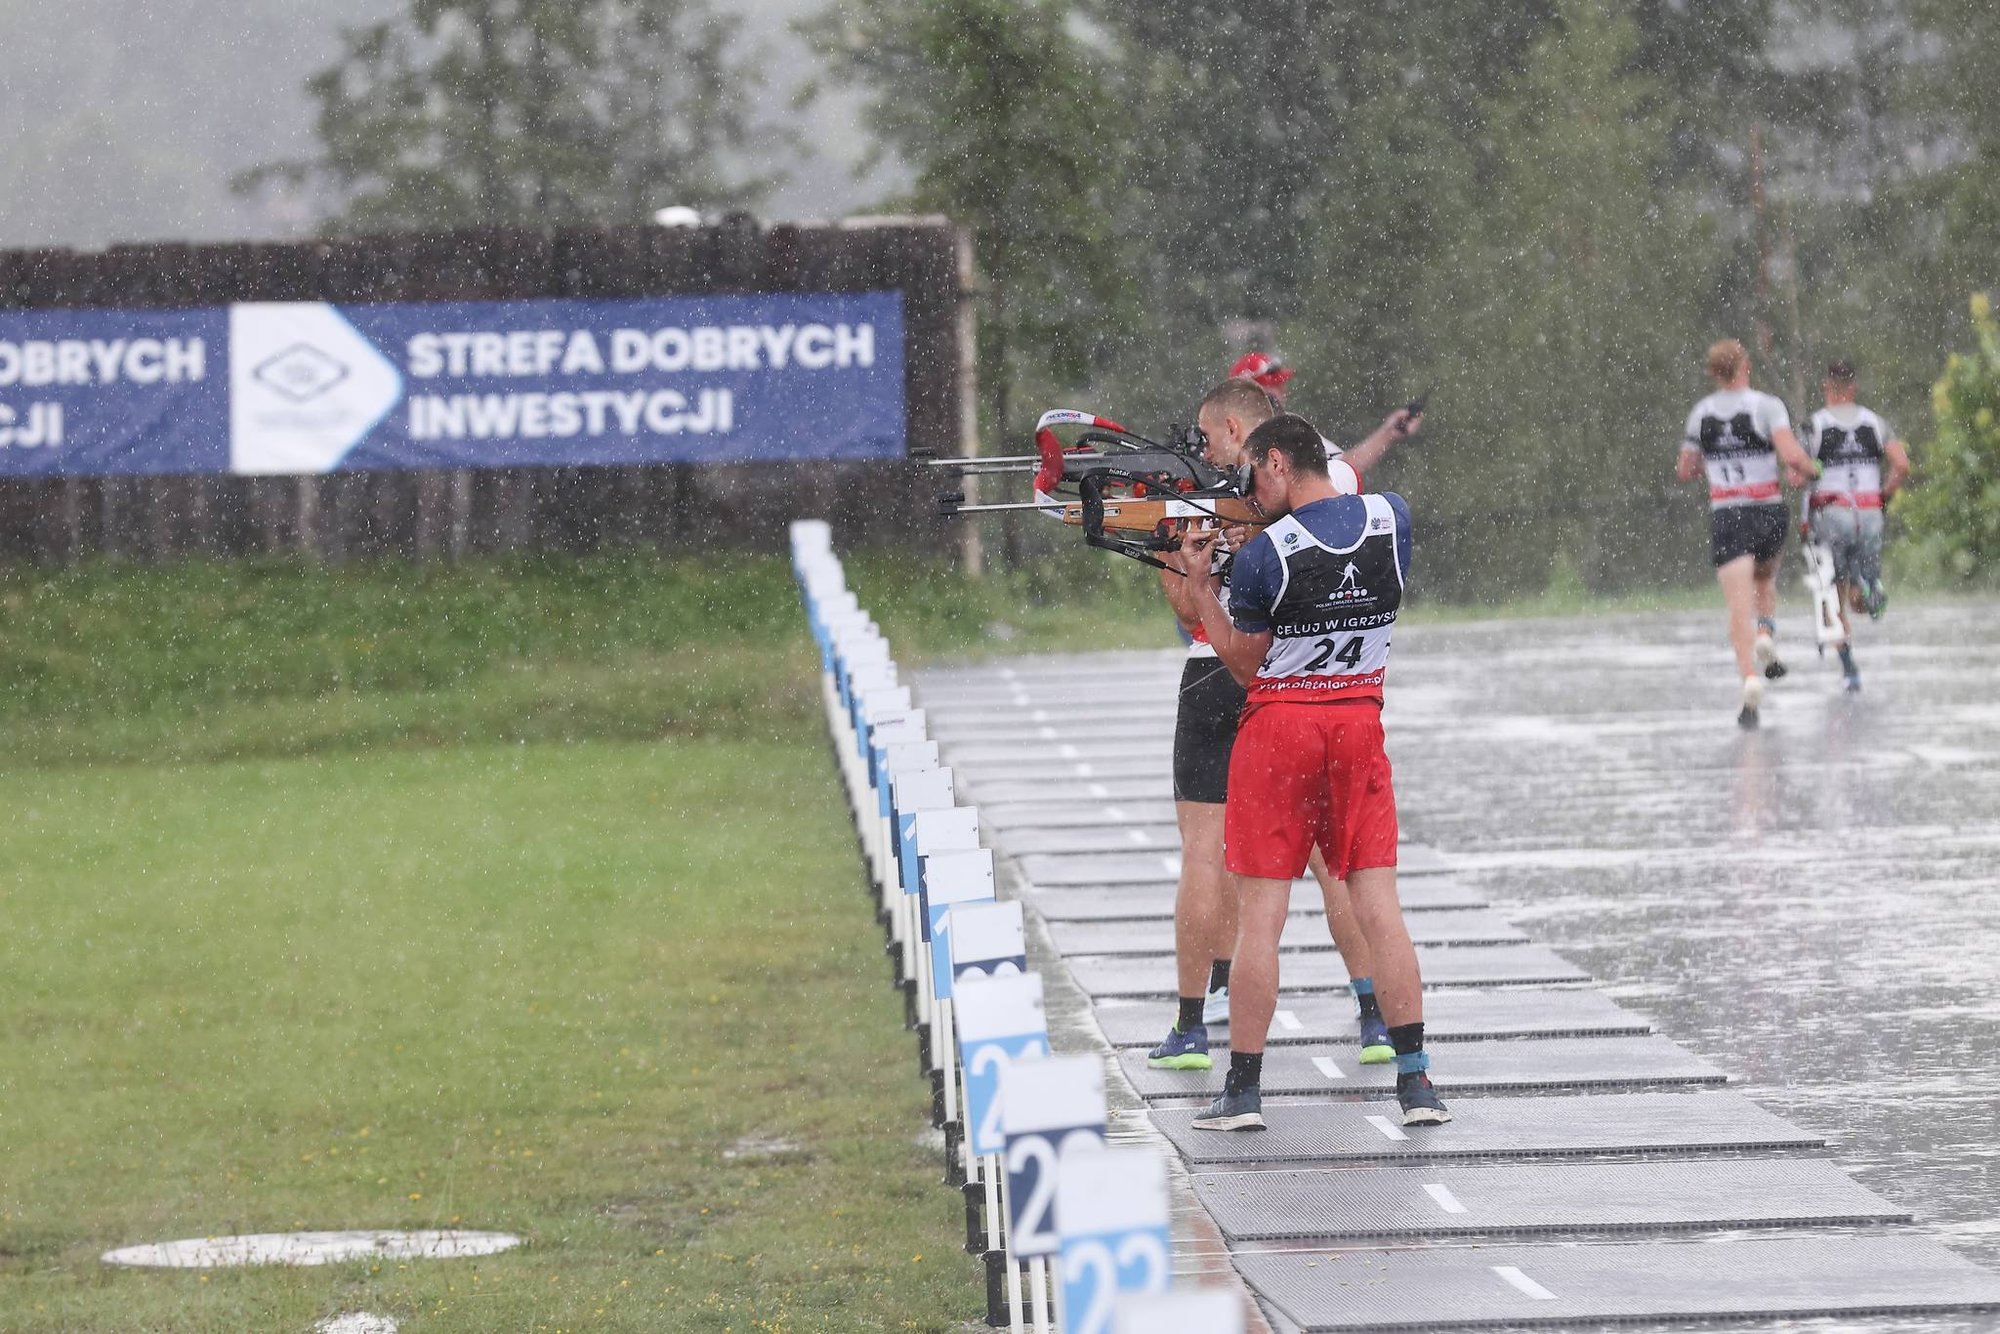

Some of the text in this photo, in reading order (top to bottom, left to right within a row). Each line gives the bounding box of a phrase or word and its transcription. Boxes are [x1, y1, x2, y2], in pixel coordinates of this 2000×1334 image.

[407, 323, 875, 378] STREFA DOBRYCH
[408, 388, 733, 439] INWESTYCJI
[1277, 609, 1397, 635] CELUJ W IGRZYSK
[1304, 636, 1364, 672] 24
